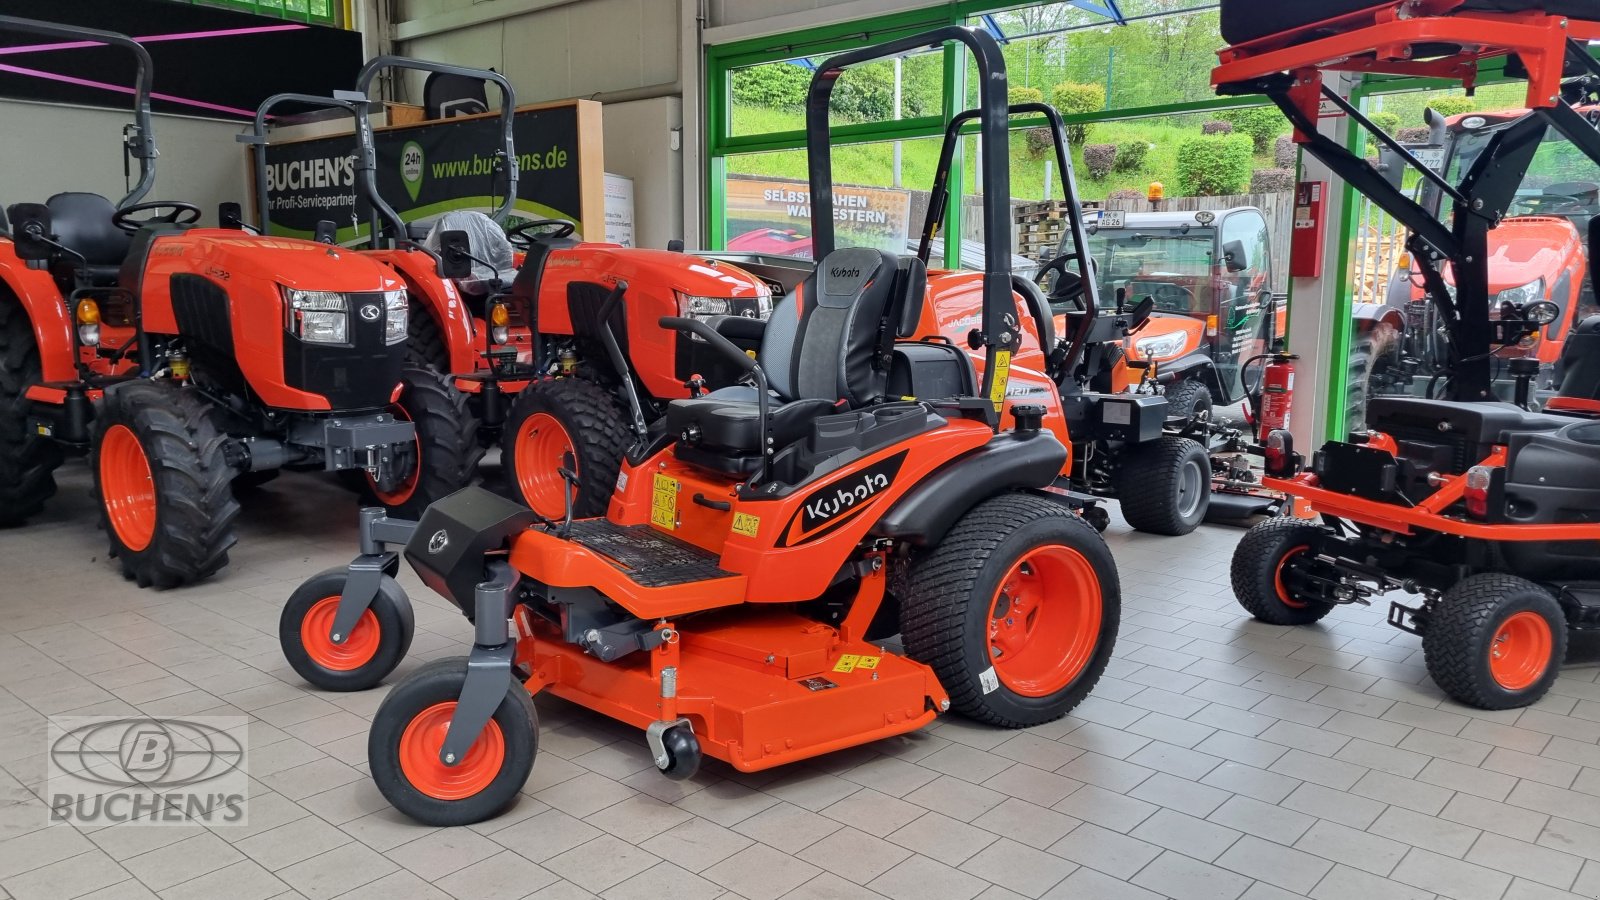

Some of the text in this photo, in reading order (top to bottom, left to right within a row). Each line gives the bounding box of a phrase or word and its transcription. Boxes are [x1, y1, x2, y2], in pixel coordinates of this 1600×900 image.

[405, 152, 421, 165] 24h
[276, 193, 358, 210] Profi-Servicepartner
[832, 207, 886, 224] ESTERN
[831, 267, 860, 278] Kubota
[806, 473, 889, 519] Kubota
